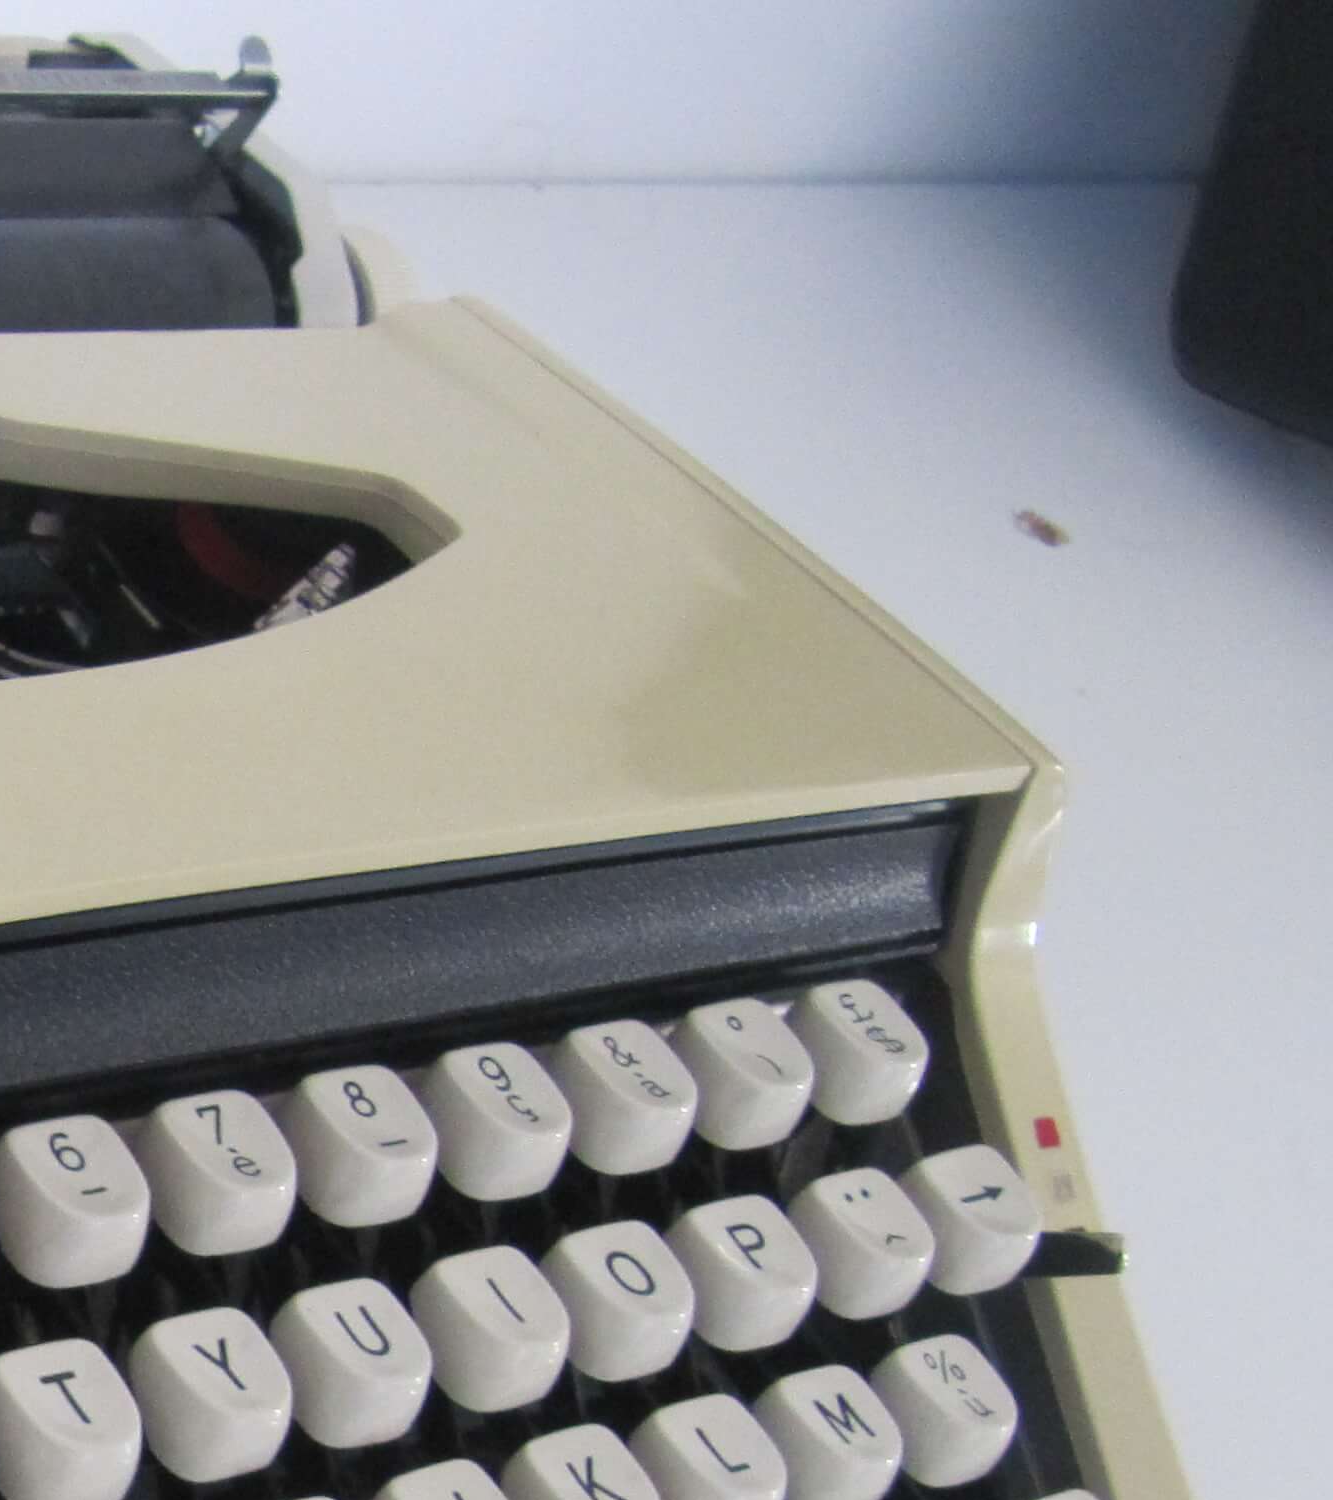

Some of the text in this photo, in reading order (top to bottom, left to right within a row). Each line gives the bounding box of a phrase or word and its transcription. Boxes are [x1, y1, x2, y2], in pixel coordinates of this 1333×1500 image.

[48, 1132, 86, 1172] 6
[195, 1104, 222, 1145] 7
[342, 1080, 377, 1118] 8
[478, 1055, 512, 1092] 9
[602, 1036, 641, 1068] &
[39, 1371, 92, 1425] T
[193, 1337, 246, 1391] Y
[334, 1305, 391, 1357] U
[725, 1223, 766, 1270] P
[695, 1427, 751, 1474] L
[813, 1392, 877, 1444] M
[922, 1349, 967, 1385] %
